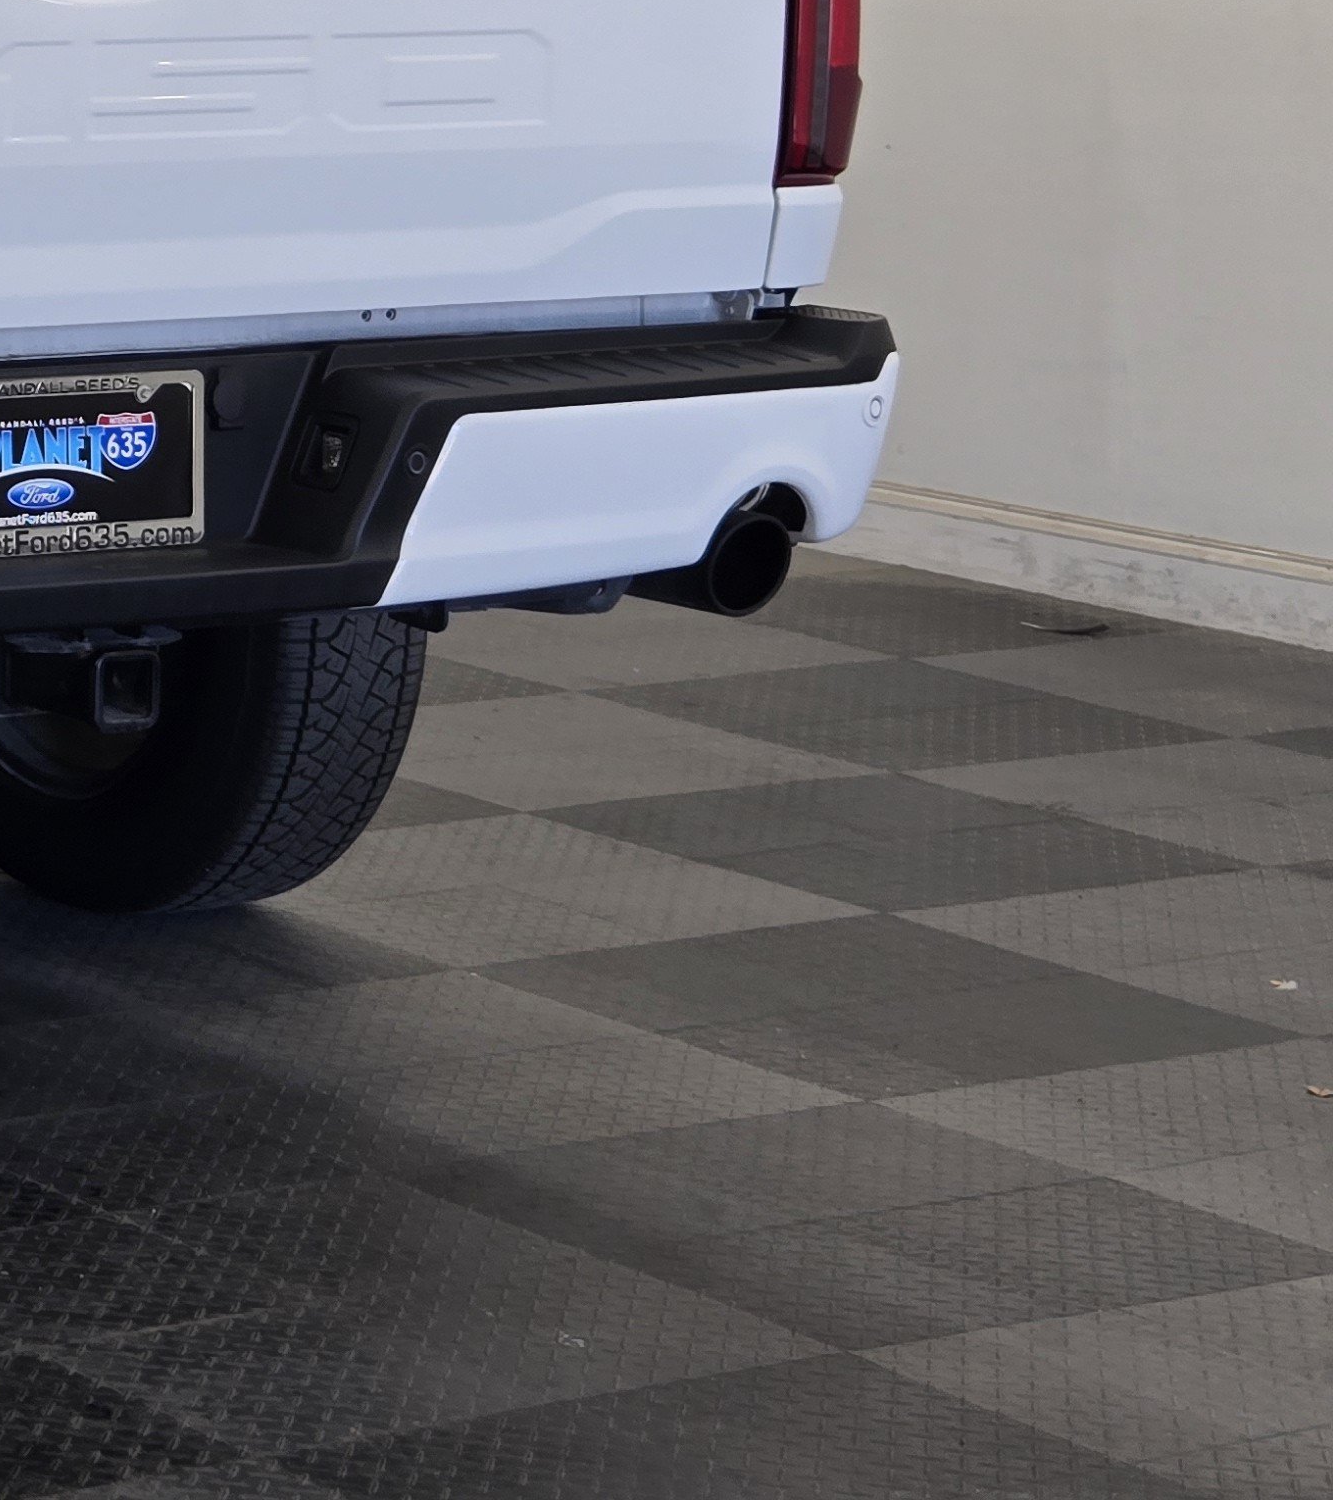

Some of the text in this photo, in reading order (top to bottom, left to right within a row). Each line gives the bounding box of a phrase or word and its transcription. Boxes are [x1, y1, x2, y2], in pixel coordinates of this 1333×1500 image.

[74, 376, 140, 392] REED'S
[107, 431, 147, 459] 635
[19, 483, 61, 505] Ford
